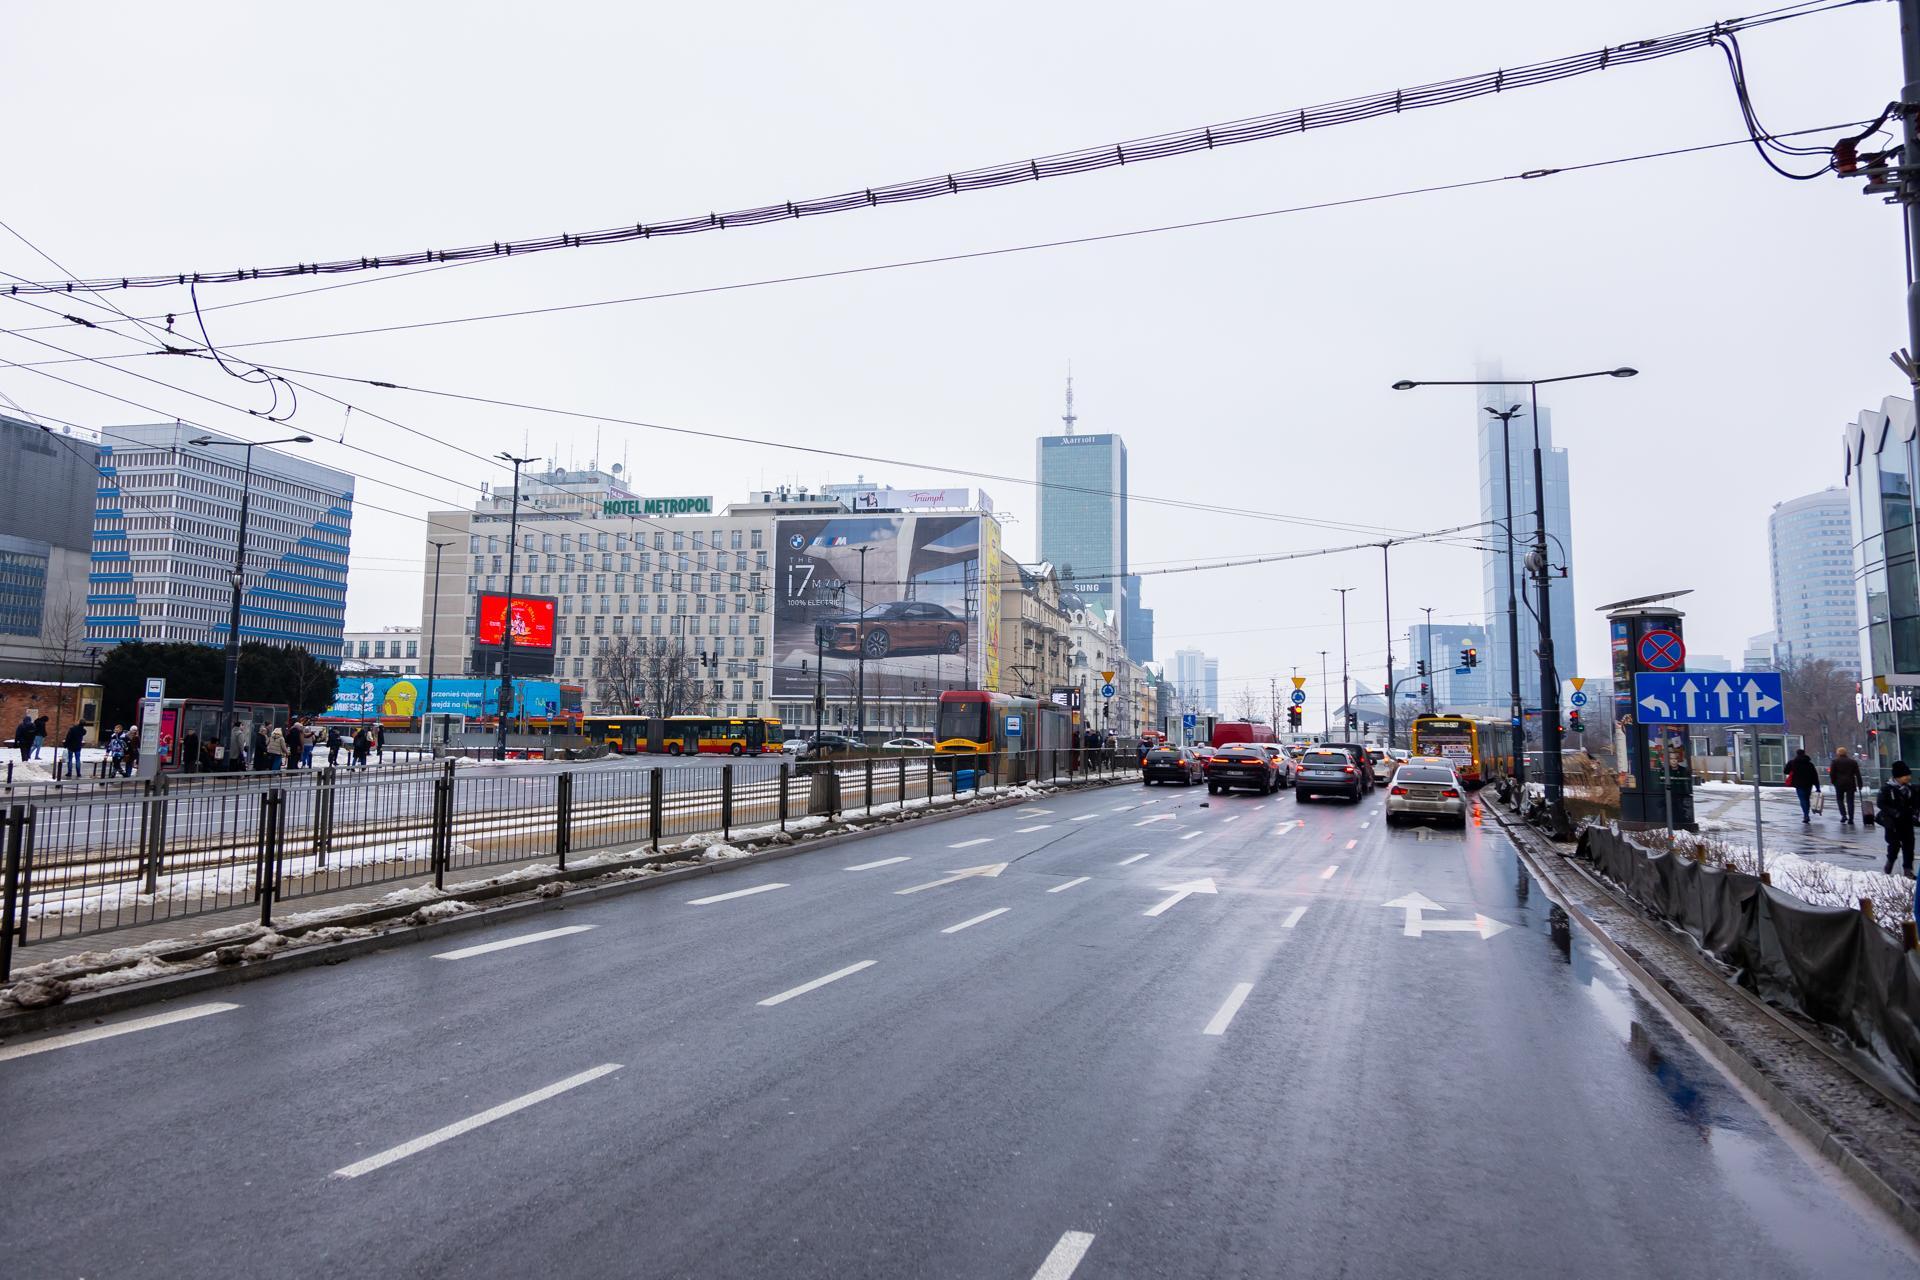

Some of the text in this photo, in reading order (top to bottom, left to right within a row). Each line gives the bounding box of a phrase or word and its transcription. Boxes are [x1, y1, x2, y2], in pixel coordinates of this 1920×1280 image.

[603, 497, 712, 515] HOTEL METROPOL
[909, 490, 945, 506] Triumph
[788, 564, 815, 597] i7
[787, 599, 806, 607] 100%
[1863, 691, 1913, 714] Bank Polski
